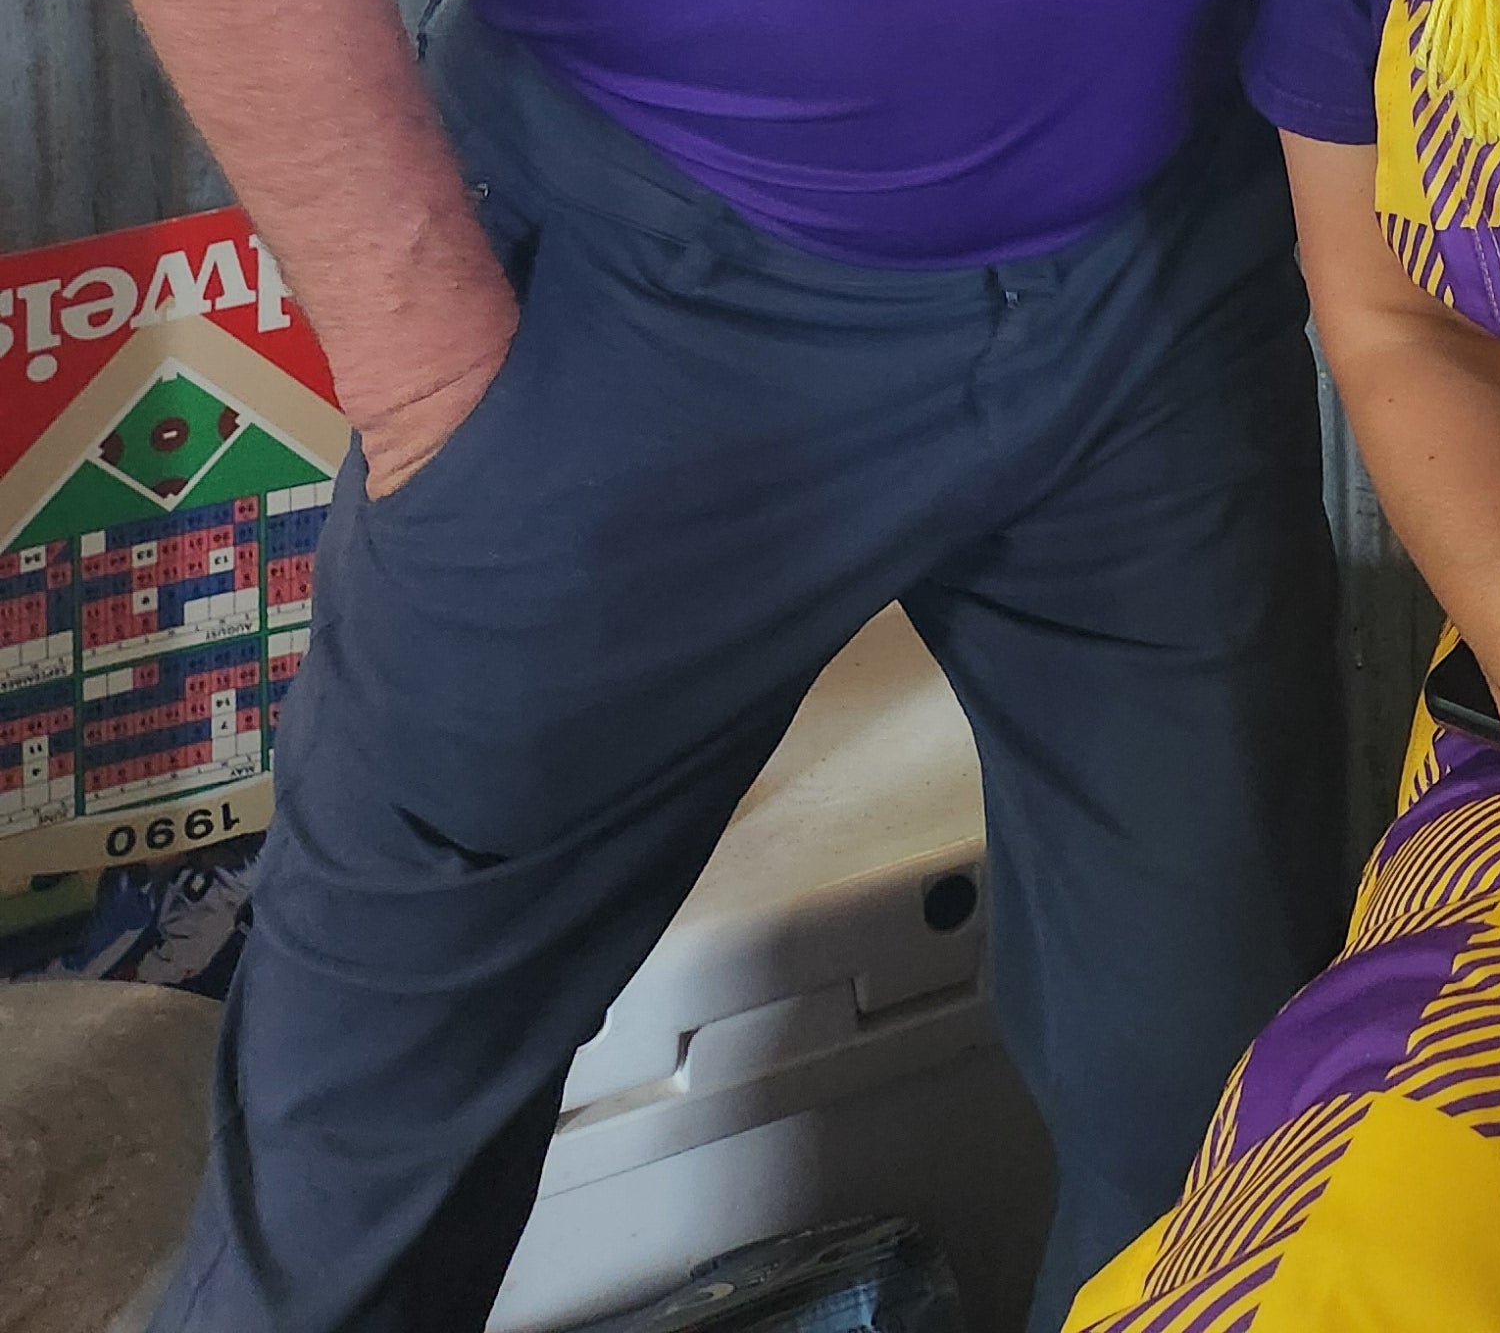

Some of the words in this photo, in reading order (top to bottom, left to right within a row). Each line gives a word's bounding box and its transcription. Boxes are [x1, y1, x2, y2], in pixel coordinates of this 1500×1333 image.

[214, 555, 229, 565] 13
[205, 623, 252, 639] AUGUST
[216, 698, 231, 710] 14
[231, 765, 255, 776] MAY
[106, 802, 240, 859] 1990
